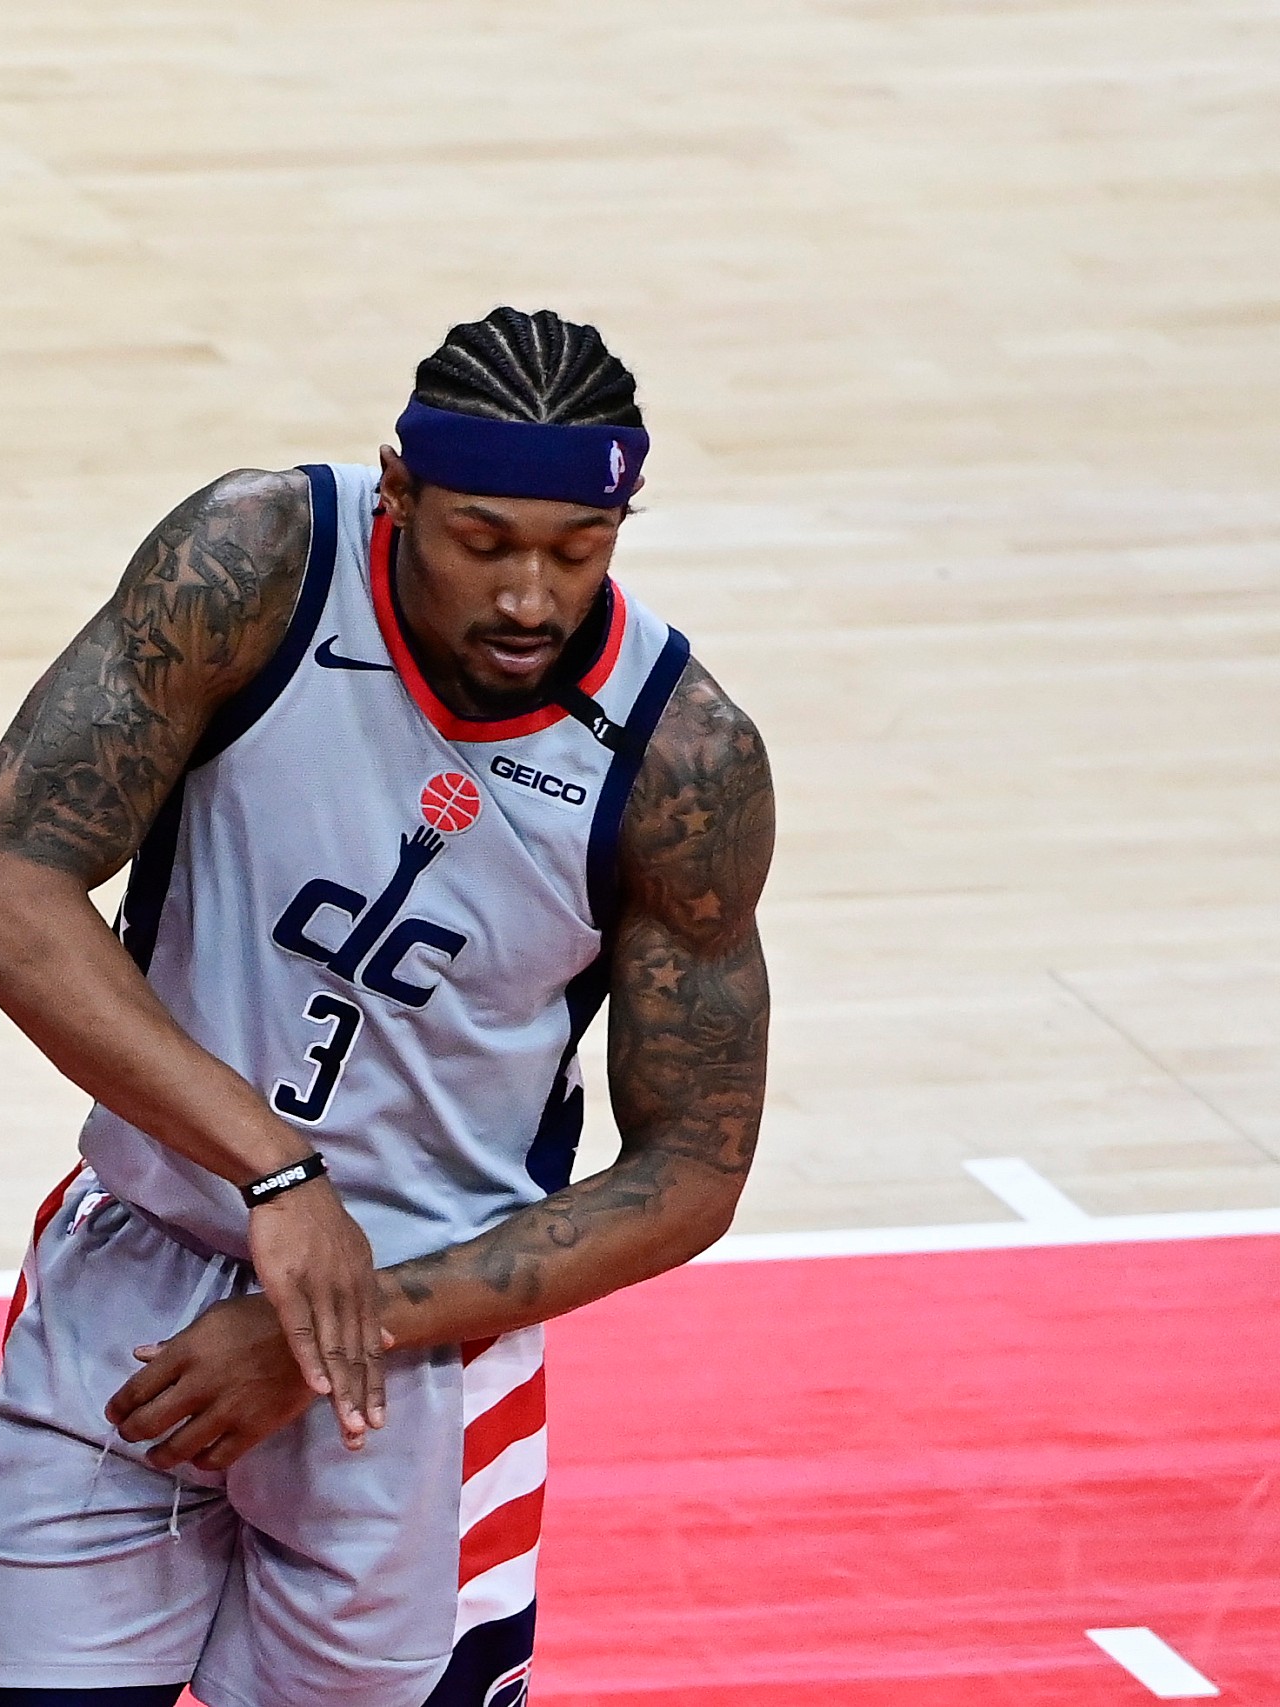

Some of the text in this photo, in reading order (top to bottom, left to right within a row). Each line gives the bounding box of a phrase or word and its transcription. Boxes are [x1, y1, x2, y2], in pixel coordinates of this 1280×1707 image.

[490, 755, 587, 805] GEICO
[270, 990, 364, 1126] 3
[251, 1165, 307, 1196] Believe
